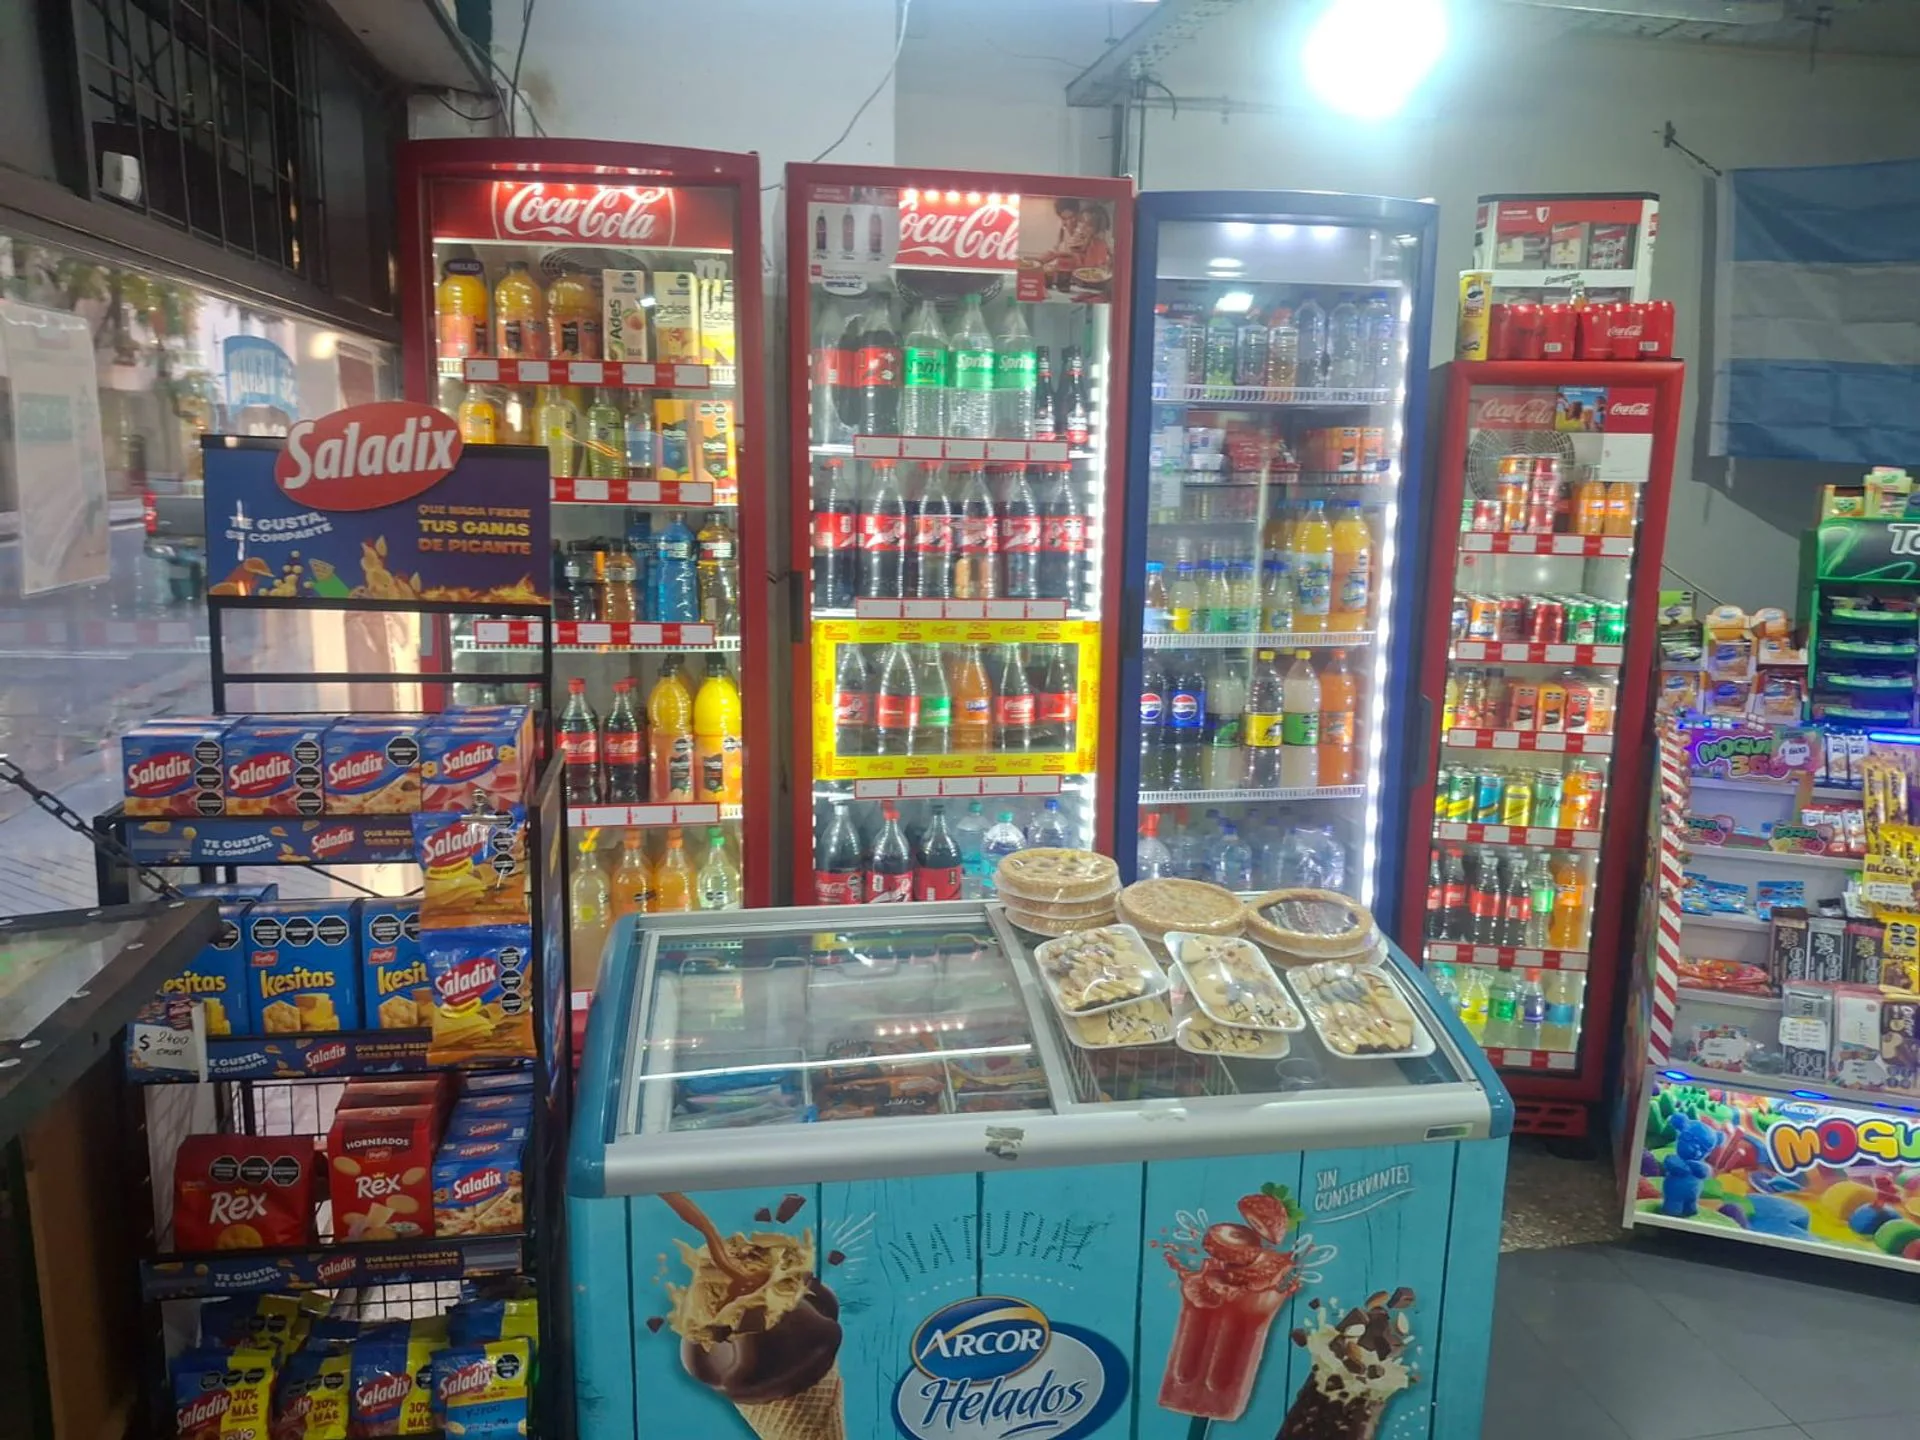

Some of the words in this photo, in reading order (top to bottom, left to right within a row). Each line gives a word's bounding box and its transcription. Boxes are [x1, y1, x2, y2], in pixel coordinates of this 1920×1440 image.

[503, 182, 656, 240] Coca-Cola
[1607, 325, 1644, 338] Coca-Cola
[1478, 397, 1555, 424] Coca-Cola
[1610, 402, 1650, 416] Coca-Cola
[284, 415, 458, 490] Saladix
[250, 522, 334, 543] COMPARTE
[418, 518, 458, 534] TUS
[462, 520, 531, 537] GANAS
[418, 538, 445, 552] DE
[448, 540, 532, 556] PICANTE
[128, 751, 191, 792] Saladix
[228, 752, 291, 792] Saladix
[328, 749, 385, 785] Saladix
[442, 743, 496, 775] Saladix
[203, 838, 220, 848] TE
[312, 829, 355, 853] Saladix
[1866, 863, 1914, 878] BLOCK
[260, 966, 336, 999] kesitas
[434, 962, 497, 1000] Saladix
[138, 1033, 150, 1052] $
[305, 1042, 347, 1070] Saladix
[345, 1137, 410, 1150] HORNEADOS
[355, 1173, 402, 1199] Rex
[453, 1171, 503, 1199] Saladix
[1314, 1164, 1412, 1212] CONSERVANTES
[1316, 1168, 1339, 1191] SIN
[209, 1192, 268, 1225] Rex
[317, 1256, 357, 1281] Saladix
[919, 1328, 1044, 1359] ARCOR
[233, 1389, 259, 1400] 30%
[356, 1378, 411, 1411] Saladix
[439, 1361, 493, 1400] Saladix
[921, 1369, 1086, 1430] Helados
[176, 1394, 230, 1436] Saladix
